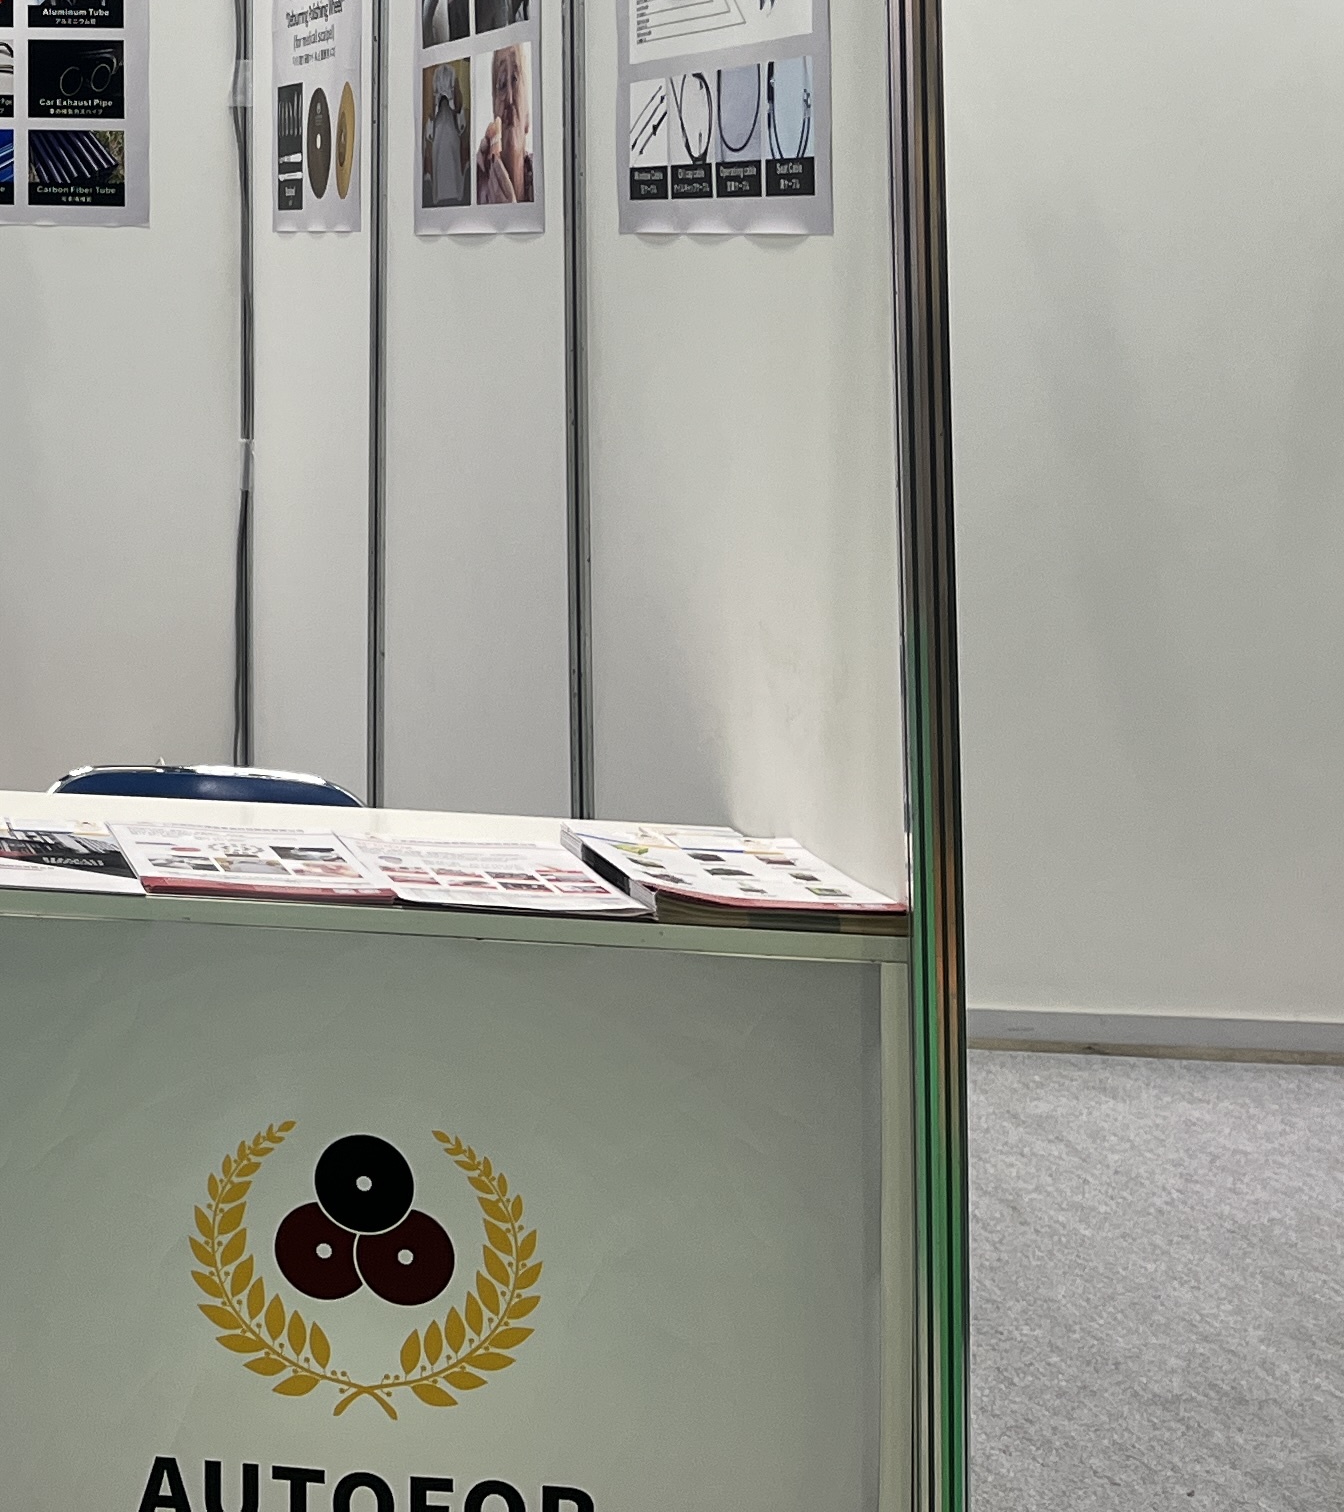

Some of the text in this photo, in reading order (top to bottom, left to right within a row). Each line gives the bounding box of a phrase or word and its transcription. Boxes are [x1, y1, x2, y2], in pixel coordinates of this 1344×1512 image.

[88, 8, 109, 16] Tube
[39, 99, 113, 108] Car Exhaust Pipe
[95, 187, 116, 195] Tube
